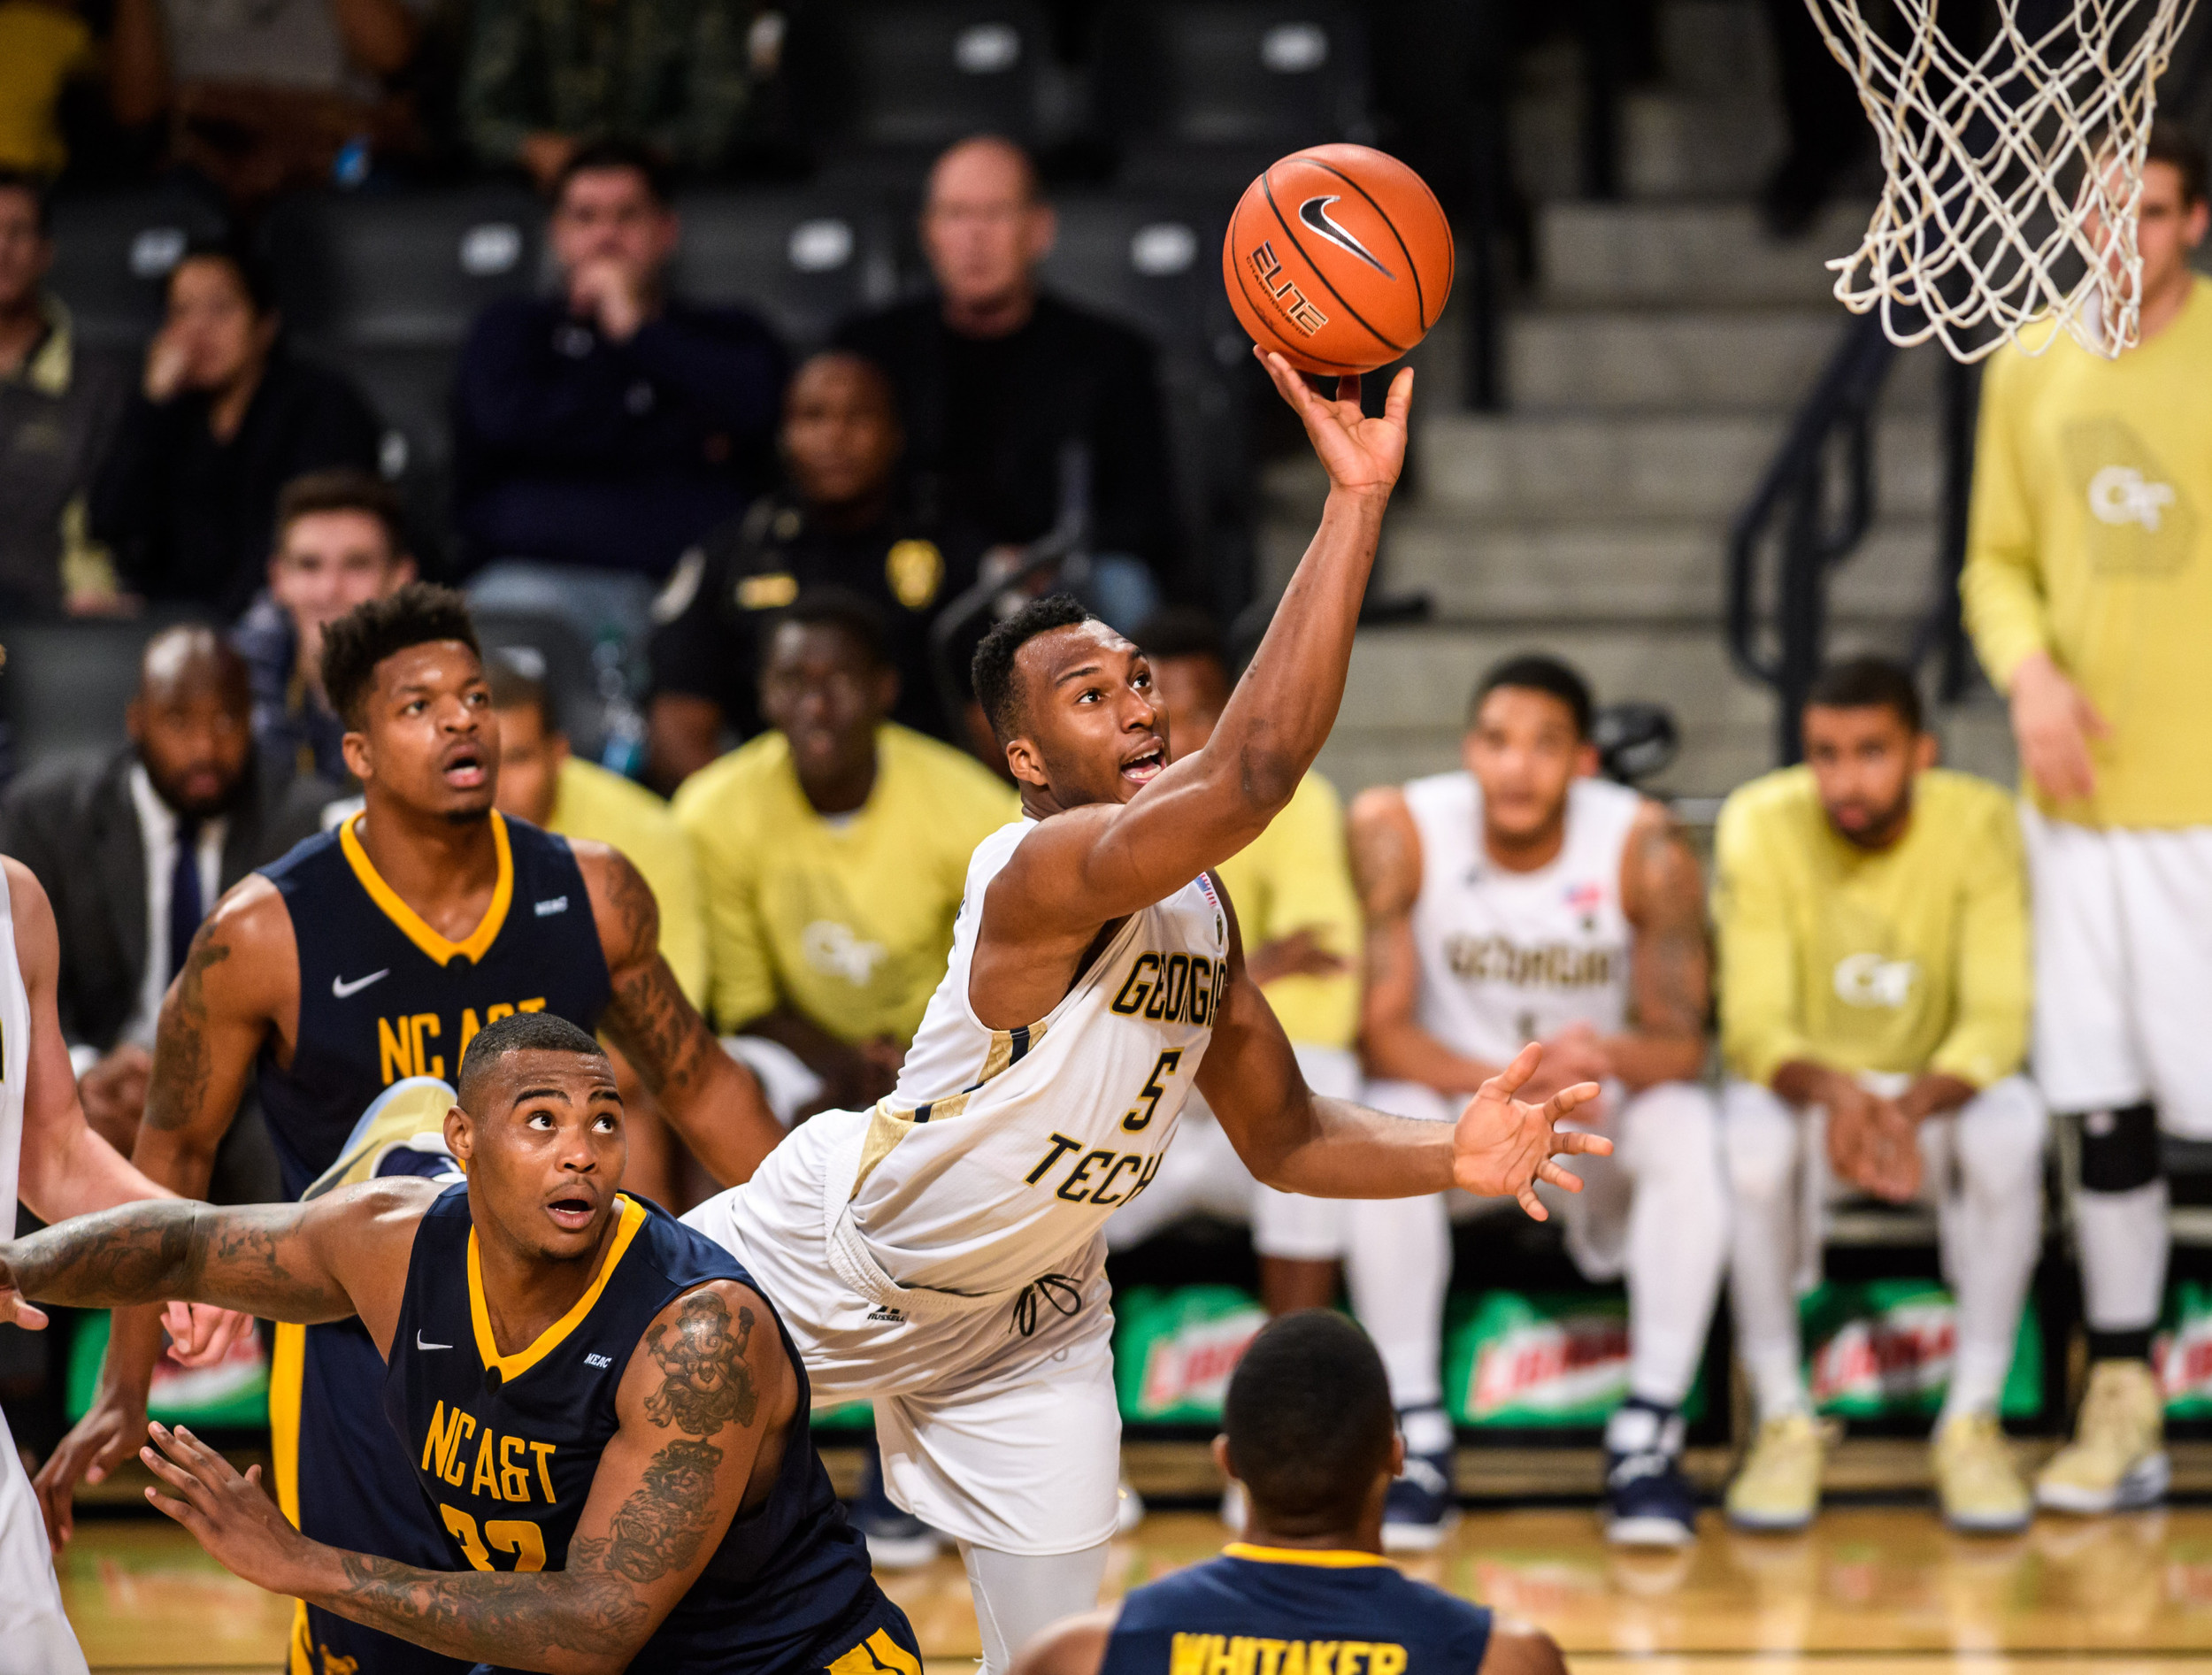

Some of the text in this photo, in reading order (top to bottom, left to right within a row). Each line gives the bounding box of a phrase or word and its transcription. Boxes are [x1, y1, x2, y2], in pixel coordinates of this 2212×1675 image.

[1246, 256, 1310, 339] CHAMPIONSHIP
[1252, 240, 1329, 335] ELITE
[1109, 949, 1228, 1029] GEOGIA
[378, 1012, 445, 1086] NC
[1119, 1046, 1185, 1134] 5
[1022, 1131, 1164, 1209] TECH
[867, 1313, 905, 1322] RUSSELL
[584, 1353, 612, 1368] MEAC
[421, 1400, 557, 1504] NC A&T
[1169, 1632, 1409, 1675] WHITAKER
